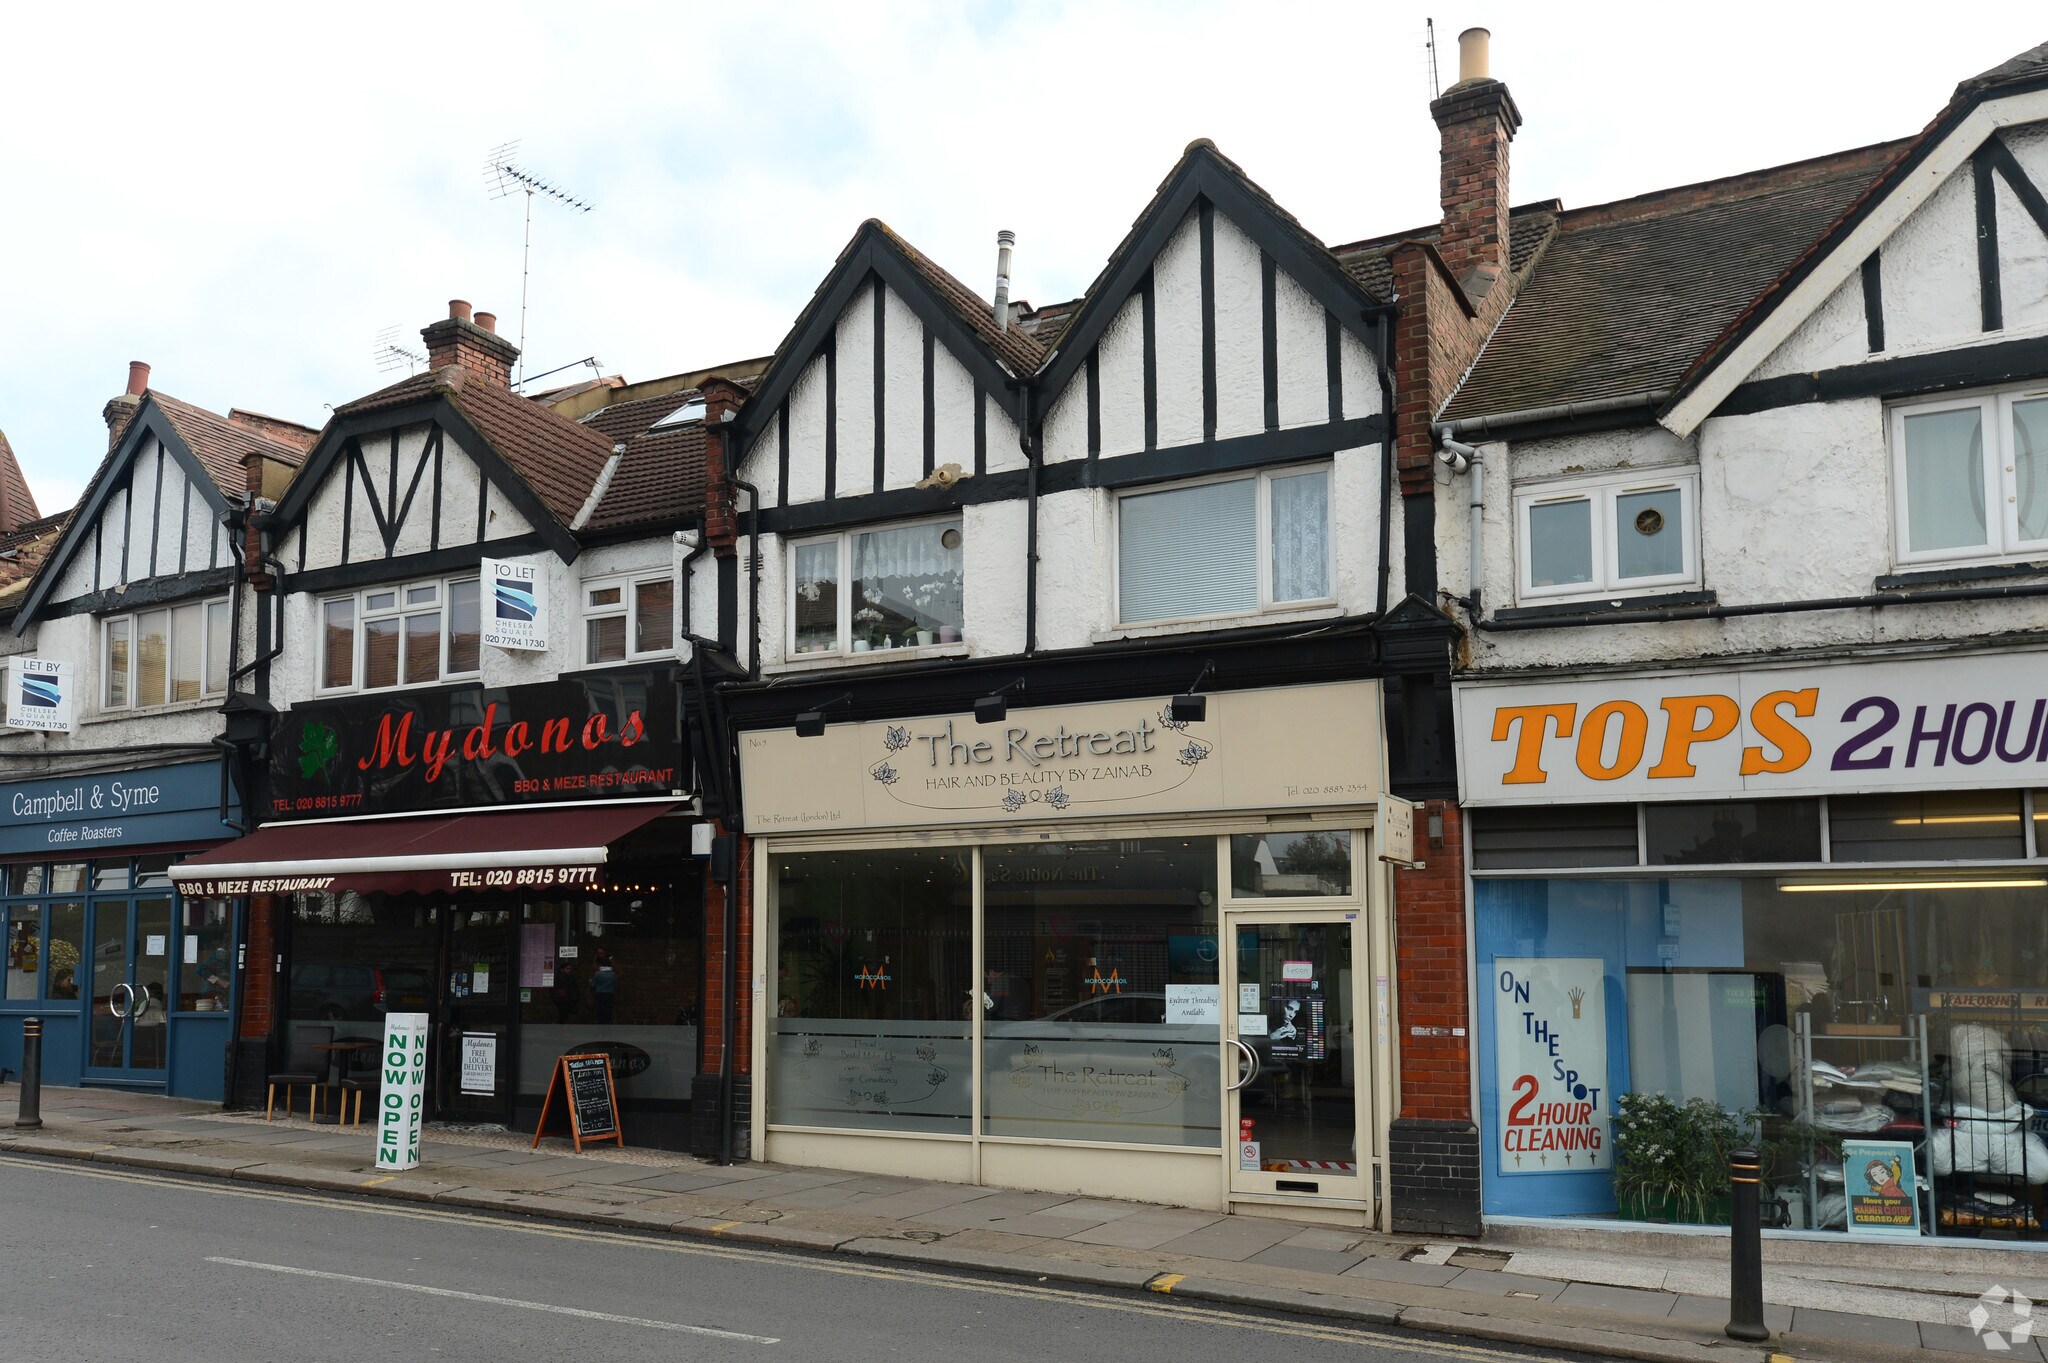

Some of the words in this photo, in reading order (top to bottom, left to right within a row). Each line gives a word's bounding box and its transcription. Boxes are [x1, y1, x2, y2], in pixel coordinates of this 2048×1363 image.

[494, 564, 511, 576] TO
[516, 567, 535, 579] LET
[495, 620, 533, 629] CHELSEA
[495, 627, 533, 636] SQUARE
[485, 634, 500, 644] 020
[502, 636, 522, 646] 7794
[525, 639, 545, 648] 1730
[24, 660, 42, 671] LET
[46, 662, 61, 672] BY
[21, 706, 57, 715] CHELSEA
[21, 712, 57, 720] SQUARE
[9, 718, 24, 726] 020
[26, 720, 45, 728] 7794
[358, 702, 644, 783] Mydonos
[917, 719, 993, 767] The
[1005, 719, 1155, 767] Retreat
[1491, 688, 1819, 785] TOPS
[1830, 696, 1900, 771] 2
[514, 779, 540, 793] BBQ
[543, 780, 550, 791] &
[553, 776, 586, 790] MEZE
[589, 768, 674, 787] RESTAURANT
[926, 776, 959, 790] HAIR
[964, 774, 996, 787] AND
[1000, 770, 1064, 786] BEAUTY
[1068, 768, 1089, 781] BY
[1092, 764, 1153, 780] ZAINAB
[1303, 787, 1320, 795] 020
[12, 787, 83, 819] Campbell
[90, 784, 104, 809] &
[110, 782, 159, 812] Syme
[273, 799, 294, 811] TEL:
[296, 798, 313, 810] 020
[315, 796, 337, 809] 8815
[340, 794, 362, 807] 9777
[755, 815, 771, 825] The
[774, 814, 799, 823] Retreat
[800, 811, 829, 822] (London)
[48, 828, 78, 843] Coffee
[81, 826, 123, 841] Roasters
[450, 872, 482, 887] TEL:
[486, 870, 513, 886] 020
[516, 868, 554, 885] 8815
[558, 867, 597, 884] 9777
[178, 882, 203, 895] BBQ
[206, 880, 215, 894] &
[218, 880, 249, 894] MEZE
[251, 877, 335, 893] RESTAURANT
[1500, 971, 1530, 1004] ON
[1169, 996, 1190, 1006] Eyebrow
[1191, 996, 1218, 1007] Threading
[1181, 1008, 1206, 1016] Available
[1523, 1012, 1560, 1057] THE
[384, 1034, 407, 1085] NOW
[411, 1034, 425, 1085] NOW
[463, 1064, 493, 1072] DELIVERY
[1038, 1059, 1077, 1084] The
[1083, 1066, 1157, 1087] Retreat
[1553, 1059, 1601, 1111] SPOT
[1507, 1074, 1539, 1126] 2
[1537, 1102, 1593, 1126] HOUR
[379, 1093, 403, 1164] OPEN
[407, 1093, 421, 1163] OPEN
[1504, 1127, 1602, 1152] CLEANING
[1854, 1205, 1884, 1215] WARMER
[1884, 1206, 1912, 1215] CLOTHES
[1863, 1197, 1882, 1205] Have
[1884, 1198, 1902, 1207] your
[1856, 1214, 1893, 1222] CLEANED
[1893, 1215, 1912, 1223] NOW
